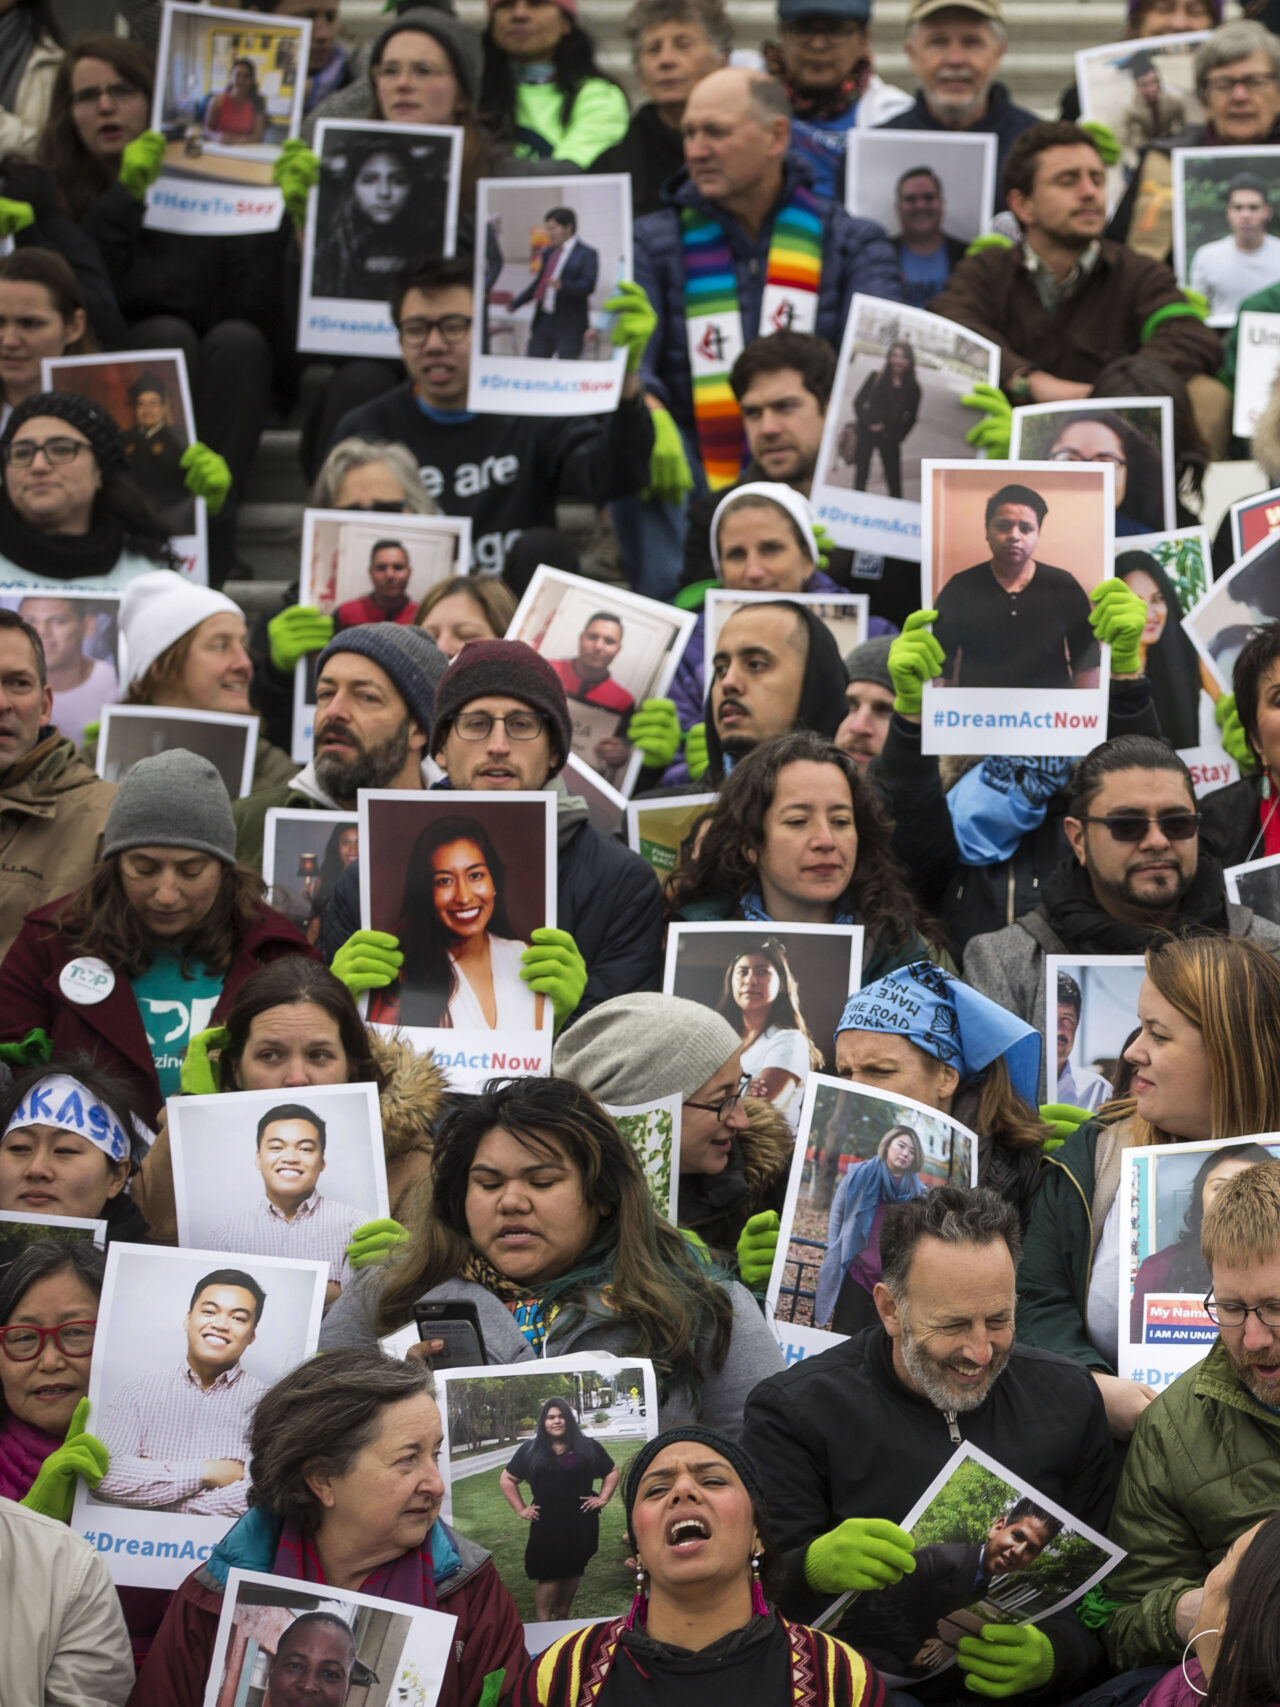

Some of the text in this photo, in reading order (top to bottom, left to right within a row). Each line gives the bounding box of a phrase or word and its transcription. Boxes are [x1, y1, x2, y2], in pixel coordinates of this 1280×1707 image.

[479, 375, 613, 393] #DreamActNow
[454, 455, 520, 498] are
[933, 710, 1098, 728] #DreamActNow
[1189, 763, 1230, 785] Stay
[876, 987, 921, 1017] MAKE
[869, 1004, 910, 1030] ROAD
[1150, 1307, 1170, 1318] My
[1149, 1330, 1219, 1340] I AM AN UNAF
